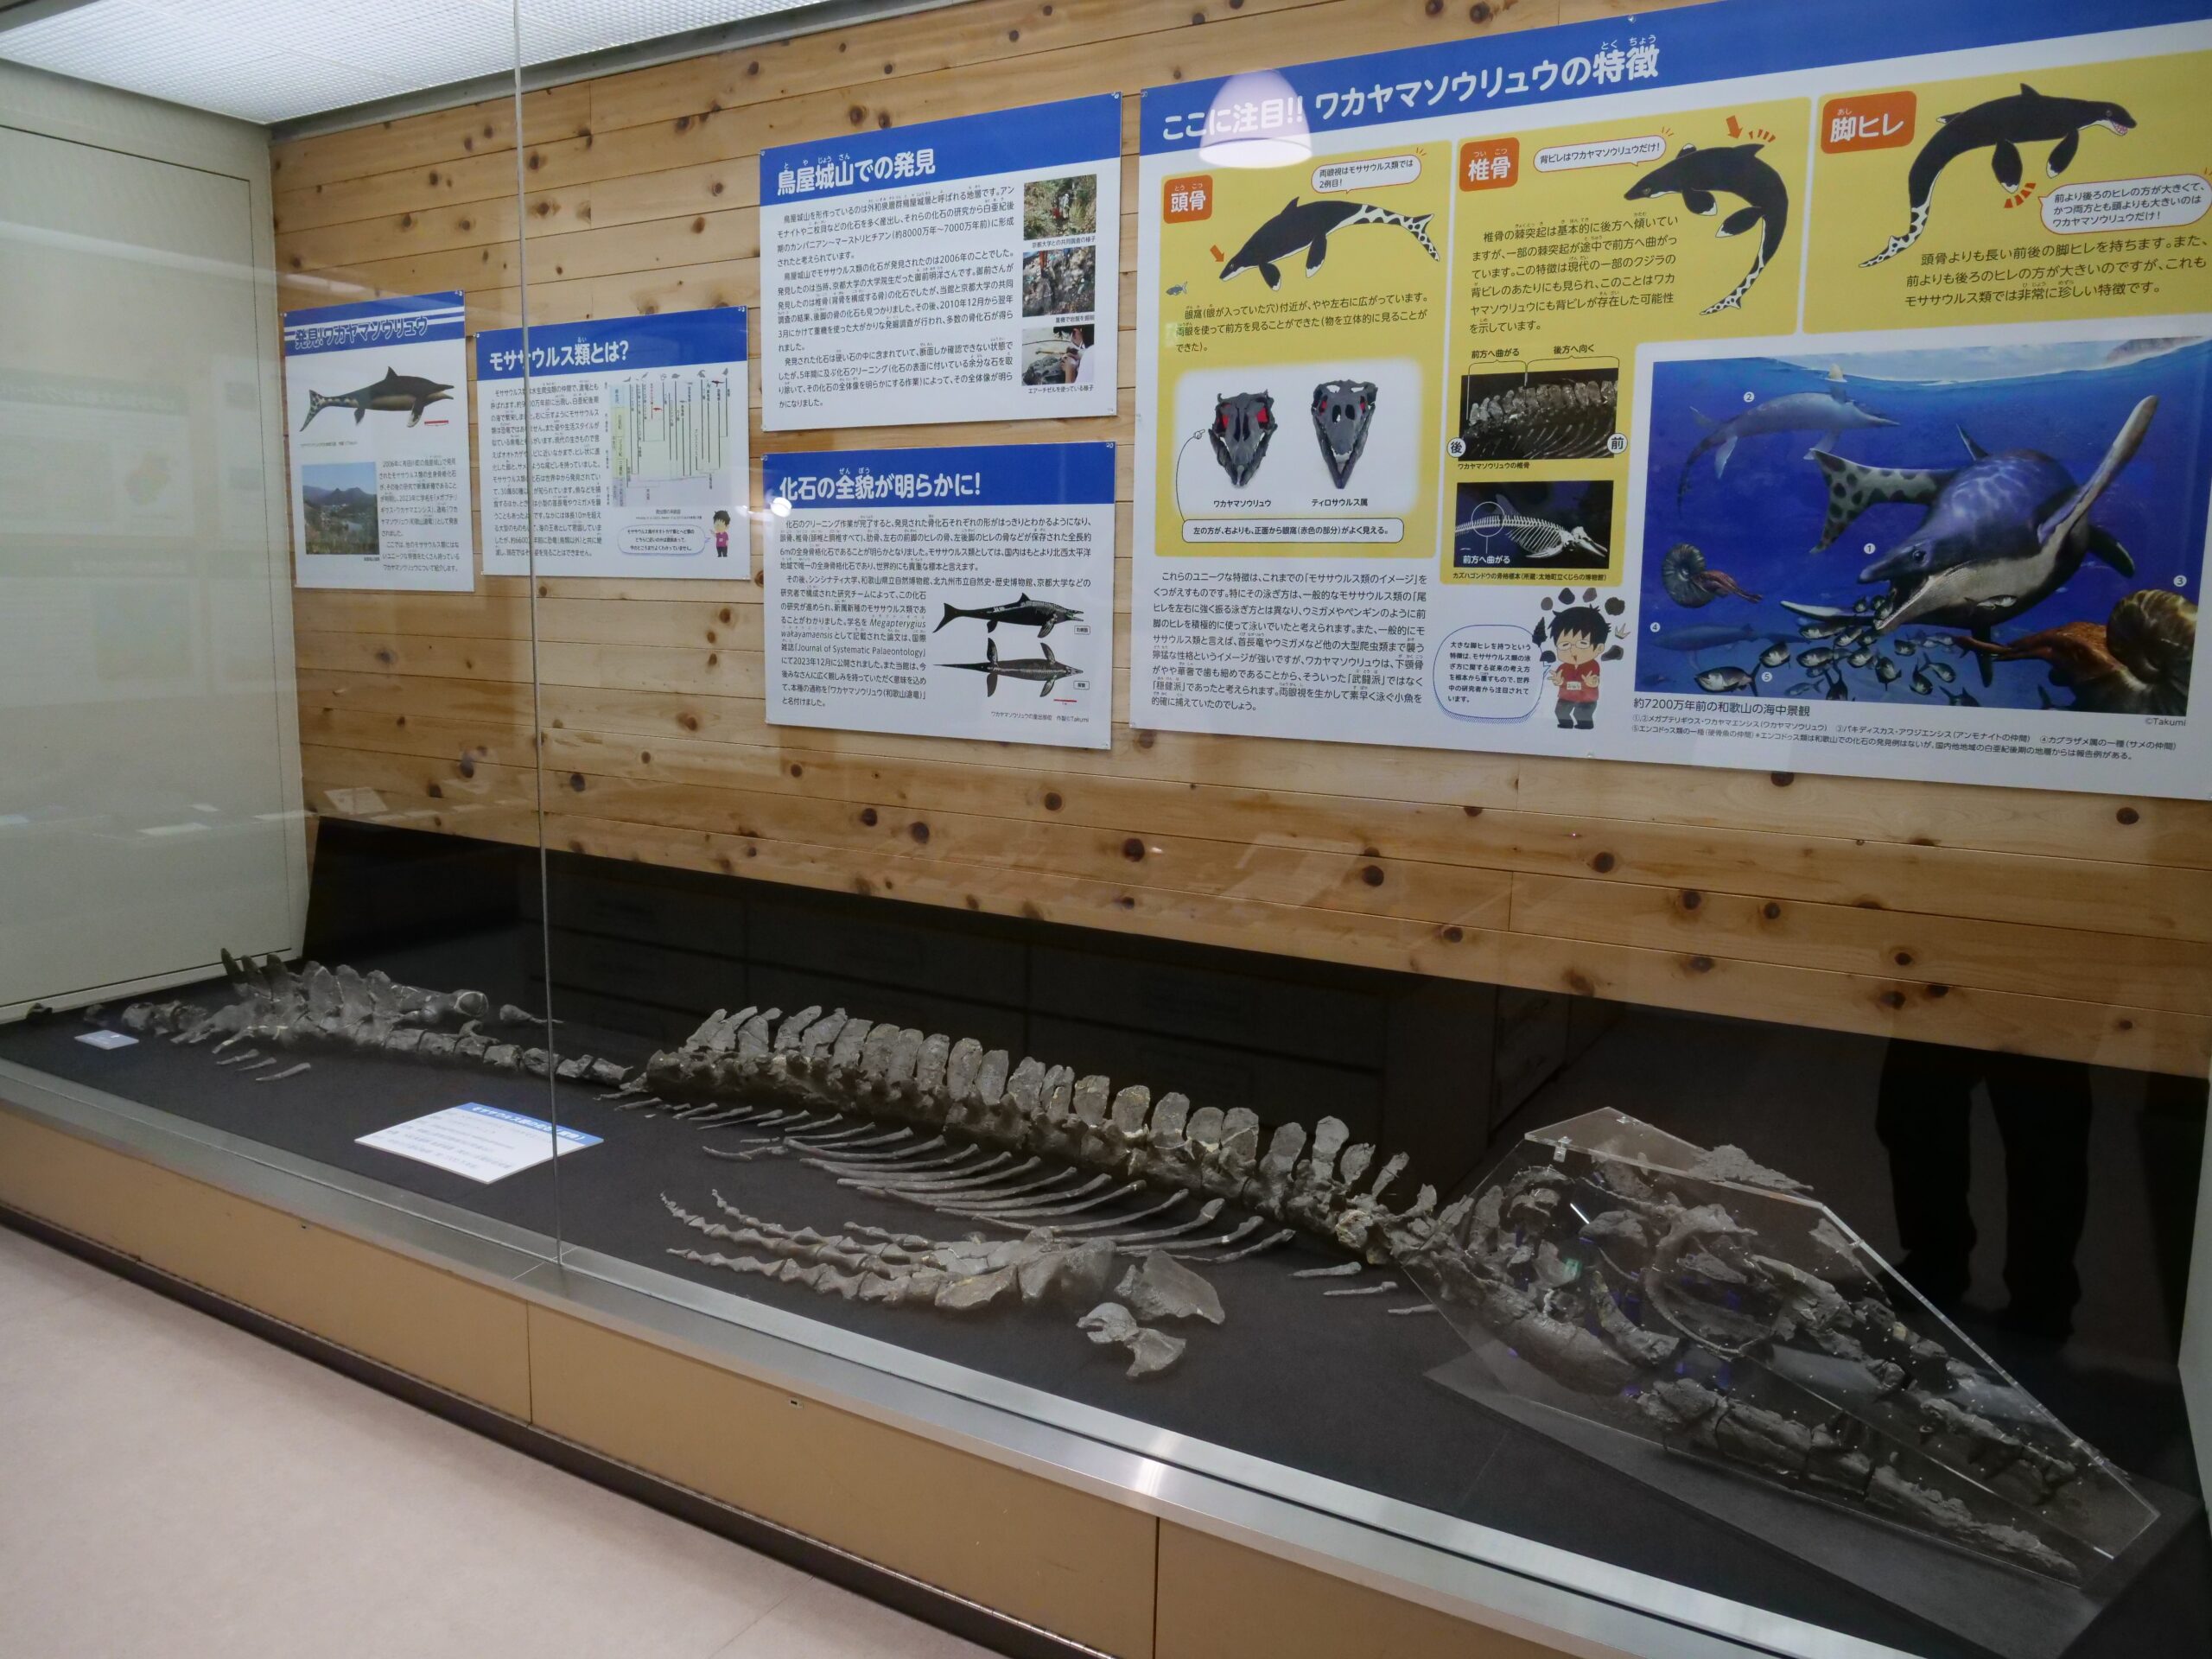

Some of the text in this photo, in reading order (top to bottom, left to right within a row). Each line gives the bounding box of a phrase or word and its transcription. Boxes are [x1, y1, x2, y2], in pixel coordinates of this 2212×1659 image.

[1601, 34, 1657, 50] とく ちょう
[1315, 45, 1660, 120] ワカヤマソウリュウの特徴
[1830, 113, 1904, 143] 脚ヒレ
[838, 152, 850, 162] さん
[778, 148, 936, 196] 鳥屋城山での発見
[1319, 159, 1413, 177] 両眼視はモササウルス類では
[1468, 156, 1510, 182] 椎骨
[1171, 189, 1206, 213] 頭骨
[2053, 195, 2201, 214] かつ両方とも頭よりも大きいのは
[778, 251, 854, 268] されたと考えられています。
[1470, 293, 1674, 315] ヤマソウリュウにも背ビレが存在した可能性
[1469, 320, 1541, 334] を示しています。
[779, 343, 804, 353] れました。
[1471, 349, 1519, 359] 前方へ曲がる
[1554, 345, 1594, 355] 後方へ向く
[779, 398, 823, 409] かになりました。
[1450, 441, 1463, 454] 後
[1611, 436, 1624, 450] 前
[779, 472, 981, 501] 化石の全貌が明らかに!
[1213, 499, 1272, 508] ワカヤマソウリュウ
[1312, 498, 1368, 507] ティロサウルス属
[1463, 555, 1510, 564] 前方へ曲がる
[869, 618, 926, 630] Megapterygius
[781, 631, 833, 640] wakayamaensis
[832, 645, 870, 655] Systematic
[782, 697, 825, 707] と名付けました。
[1633, 697, 1810, 717] 約7200万年前の和歌山の海中景観
